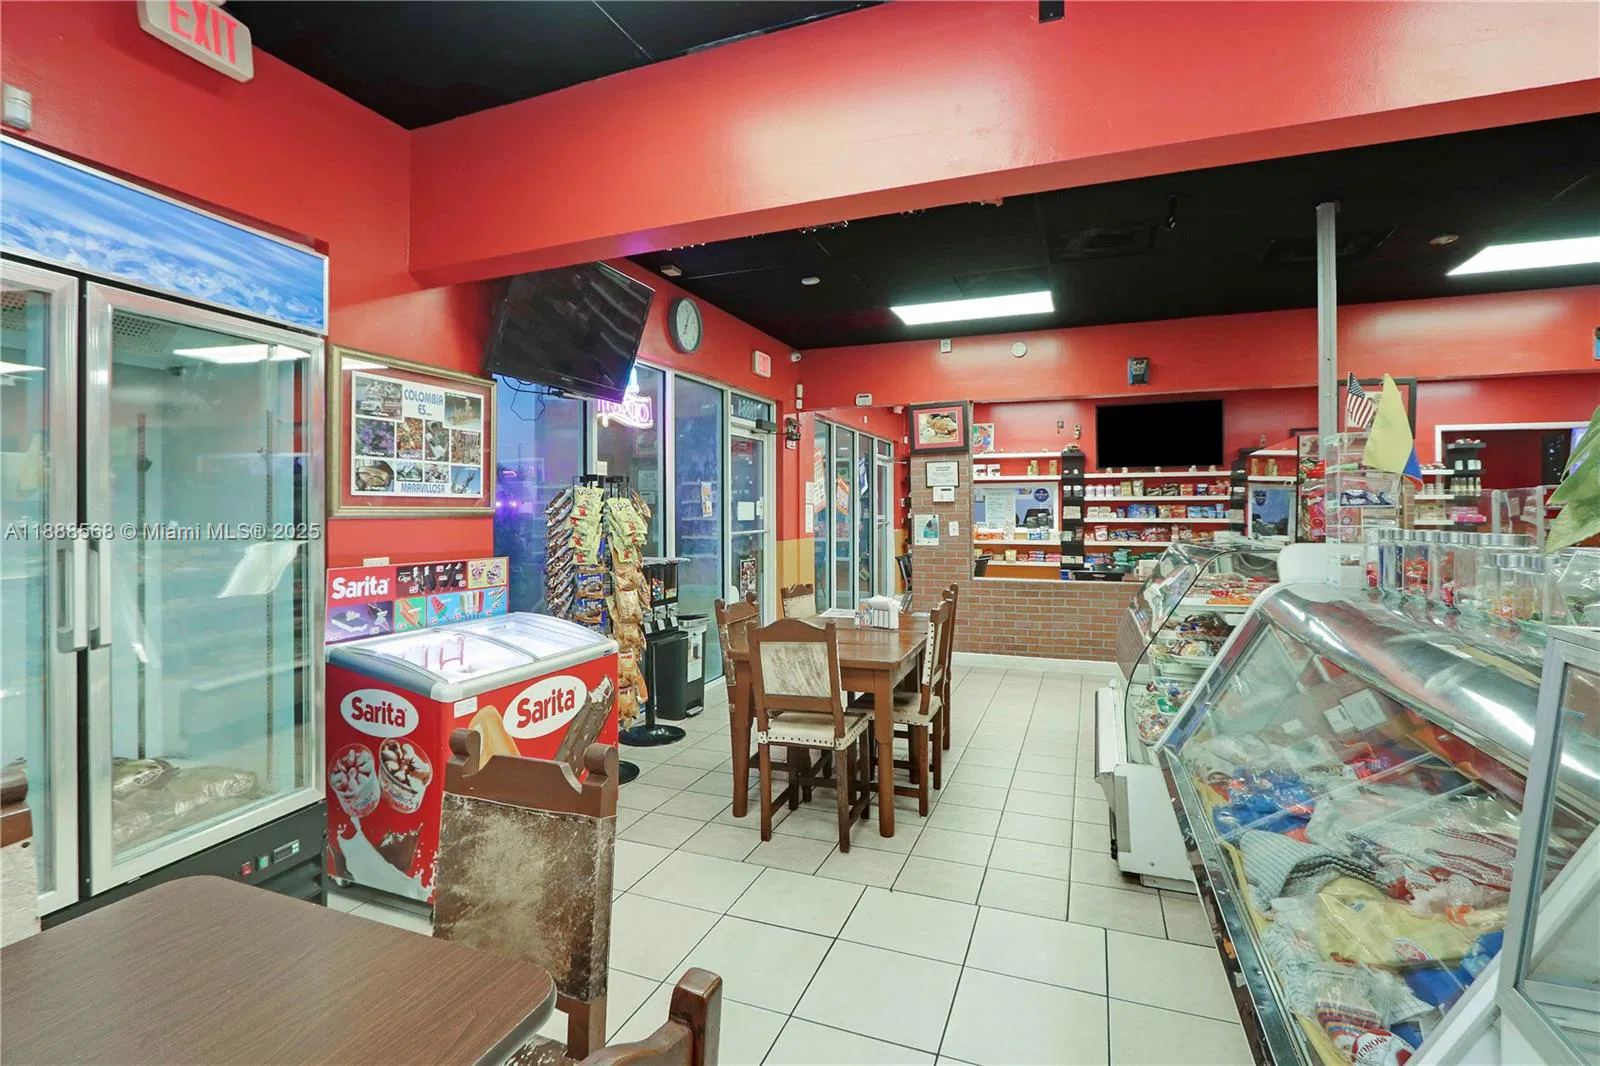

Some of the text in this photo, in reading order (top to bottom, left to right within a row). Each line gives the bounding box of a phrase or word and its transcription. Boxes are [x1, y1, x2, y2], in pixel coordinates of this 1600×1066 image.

[168, 0, 238, 65] EXIT
[404, 388, 443, 404] COLOMBIA
[401, 483, 445, 494] MARAVILLOSA
[331, 575, 389, 600] Sarita
[351, 696, 406, 728] Sarita
[515, 687, 576, 730] Sarita
